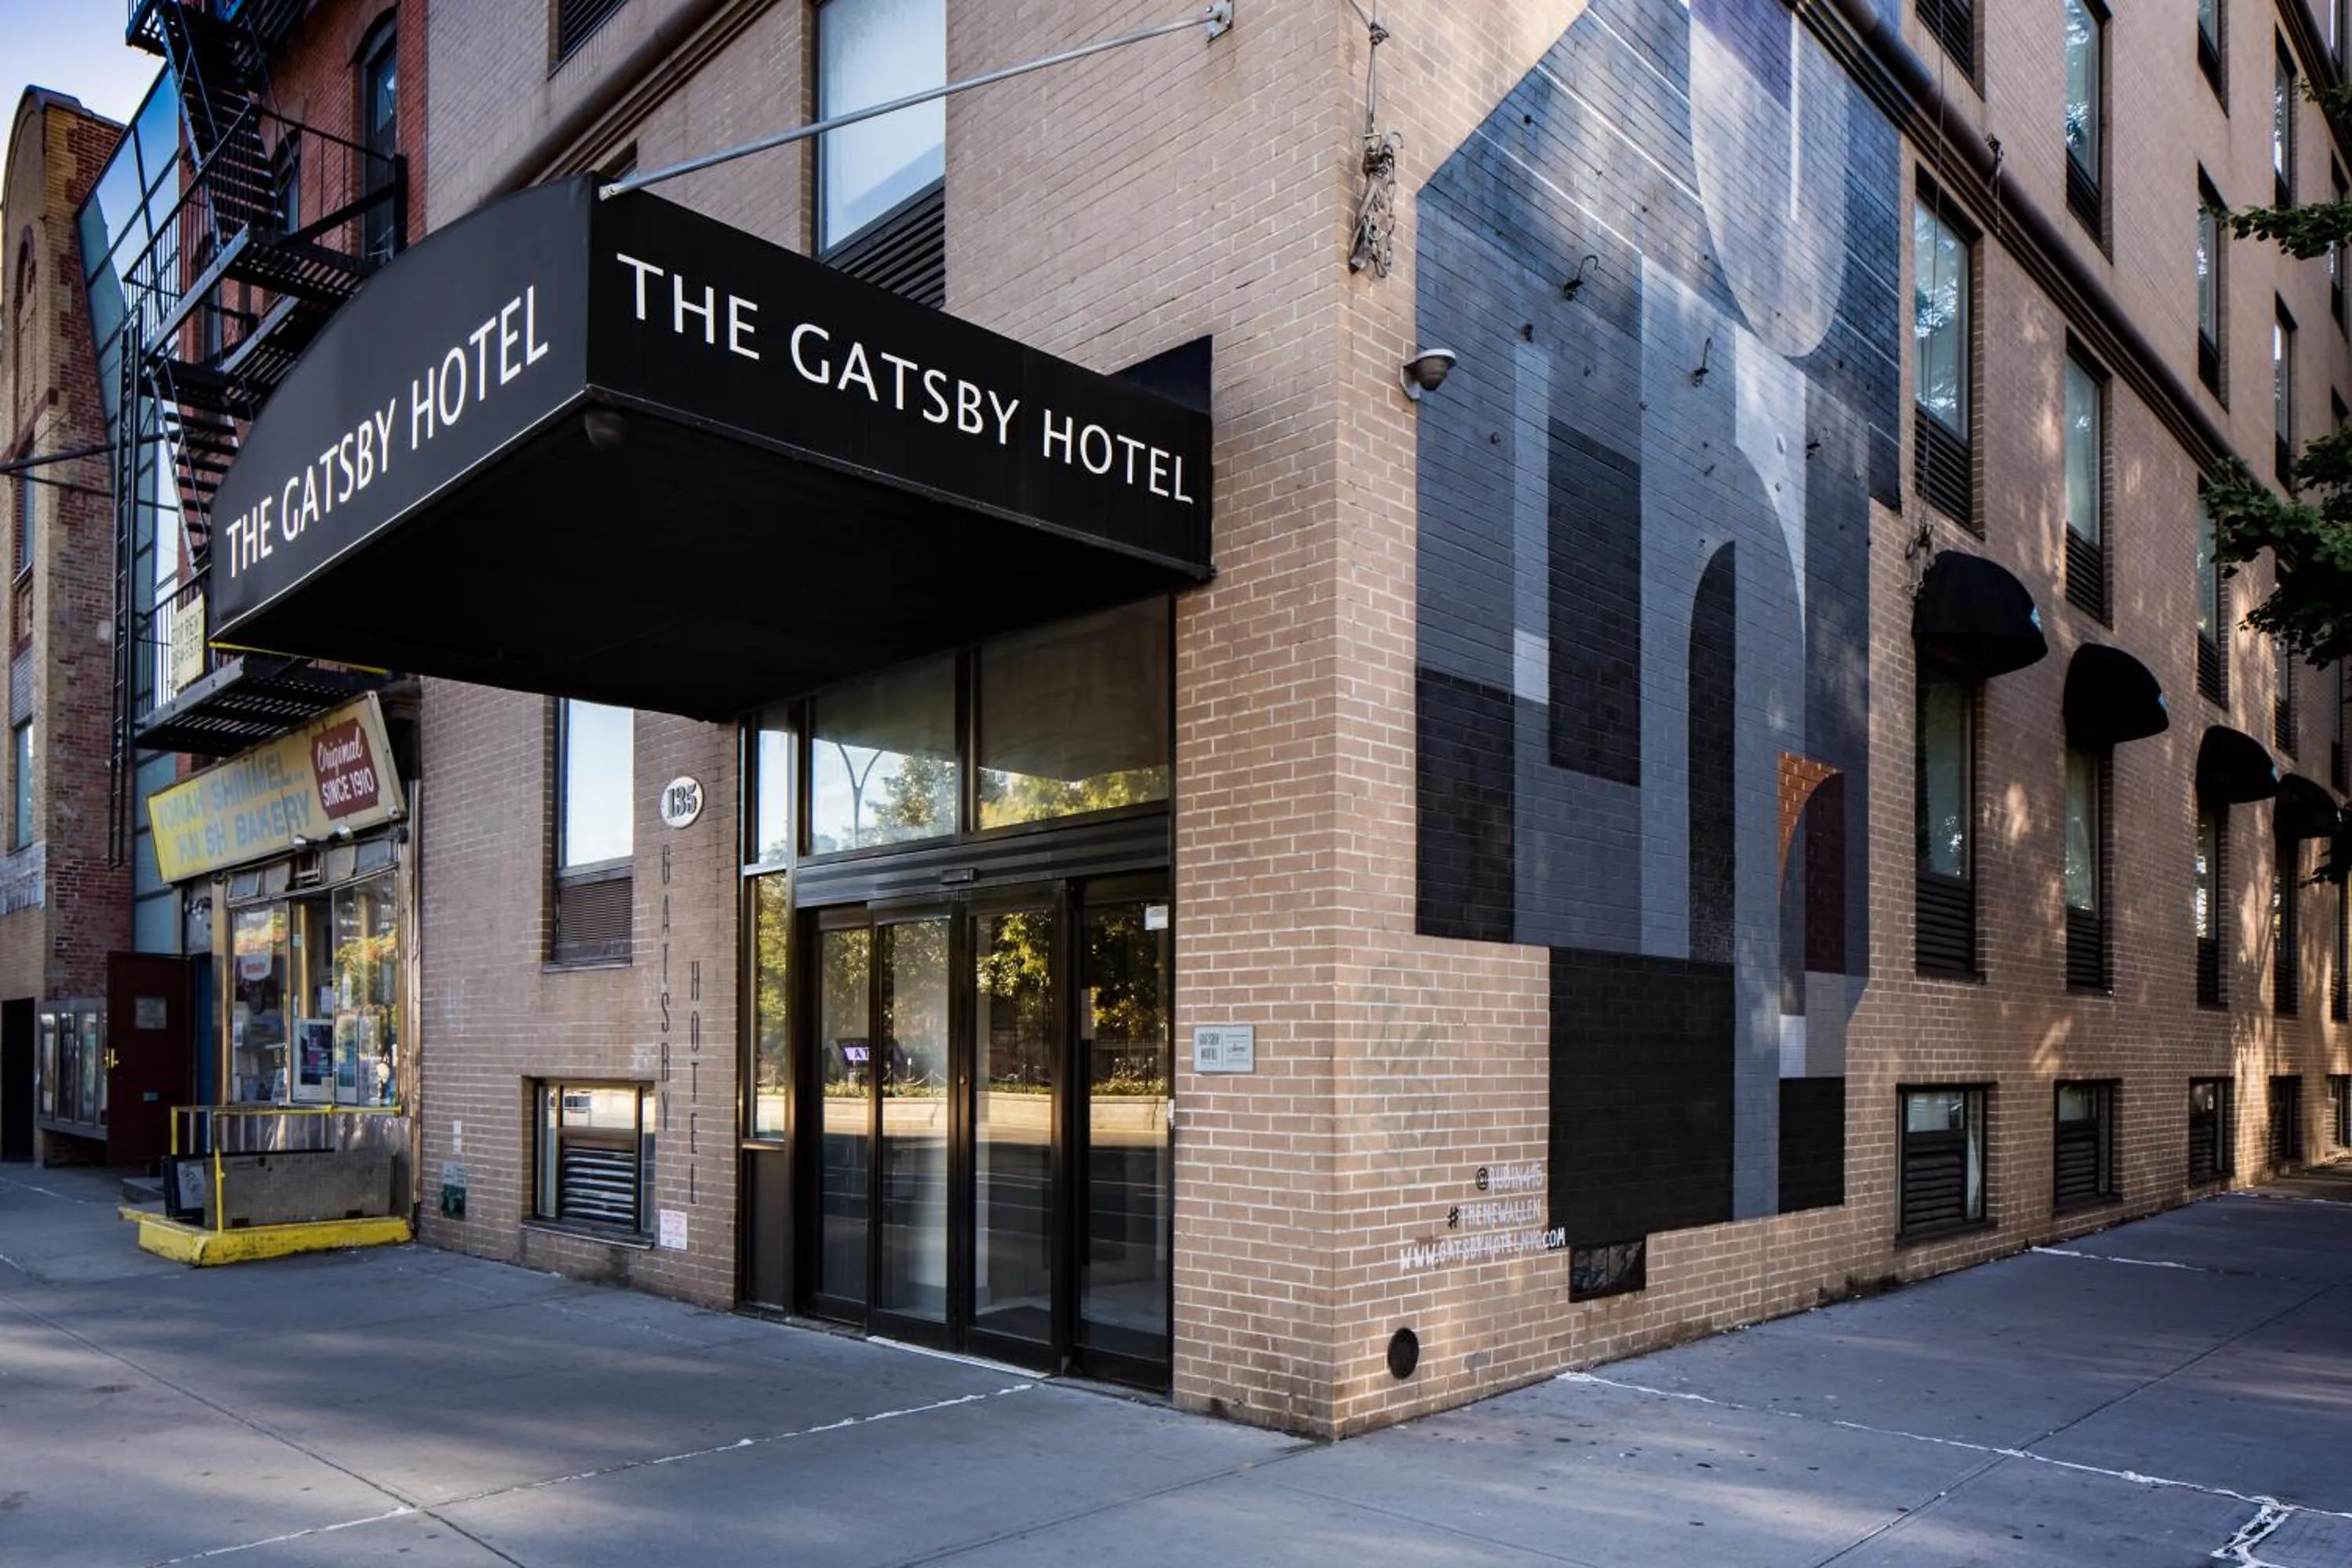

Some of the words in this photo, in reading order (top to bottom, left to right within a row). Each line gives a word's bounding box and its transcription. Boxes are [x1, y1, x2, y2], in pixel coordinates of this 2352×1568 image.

[617, 252, 760, 360] THE
[790, 323, 1020, 445] GATSBY
[1043, 408, 1193, 504] HOTEL
[226, 506, 274, 579] THE
[280, 397, 396, 536] GATSBY
[411, 285, 549, 450] HOTEL
[318, 727, 363, 775] Original
[322, 779, 350, 807] SINCE
[350, 768, 375, 797] 1910
[667, 783, 697, 819] 135
[234, 789, 311, 847] BAKERY
